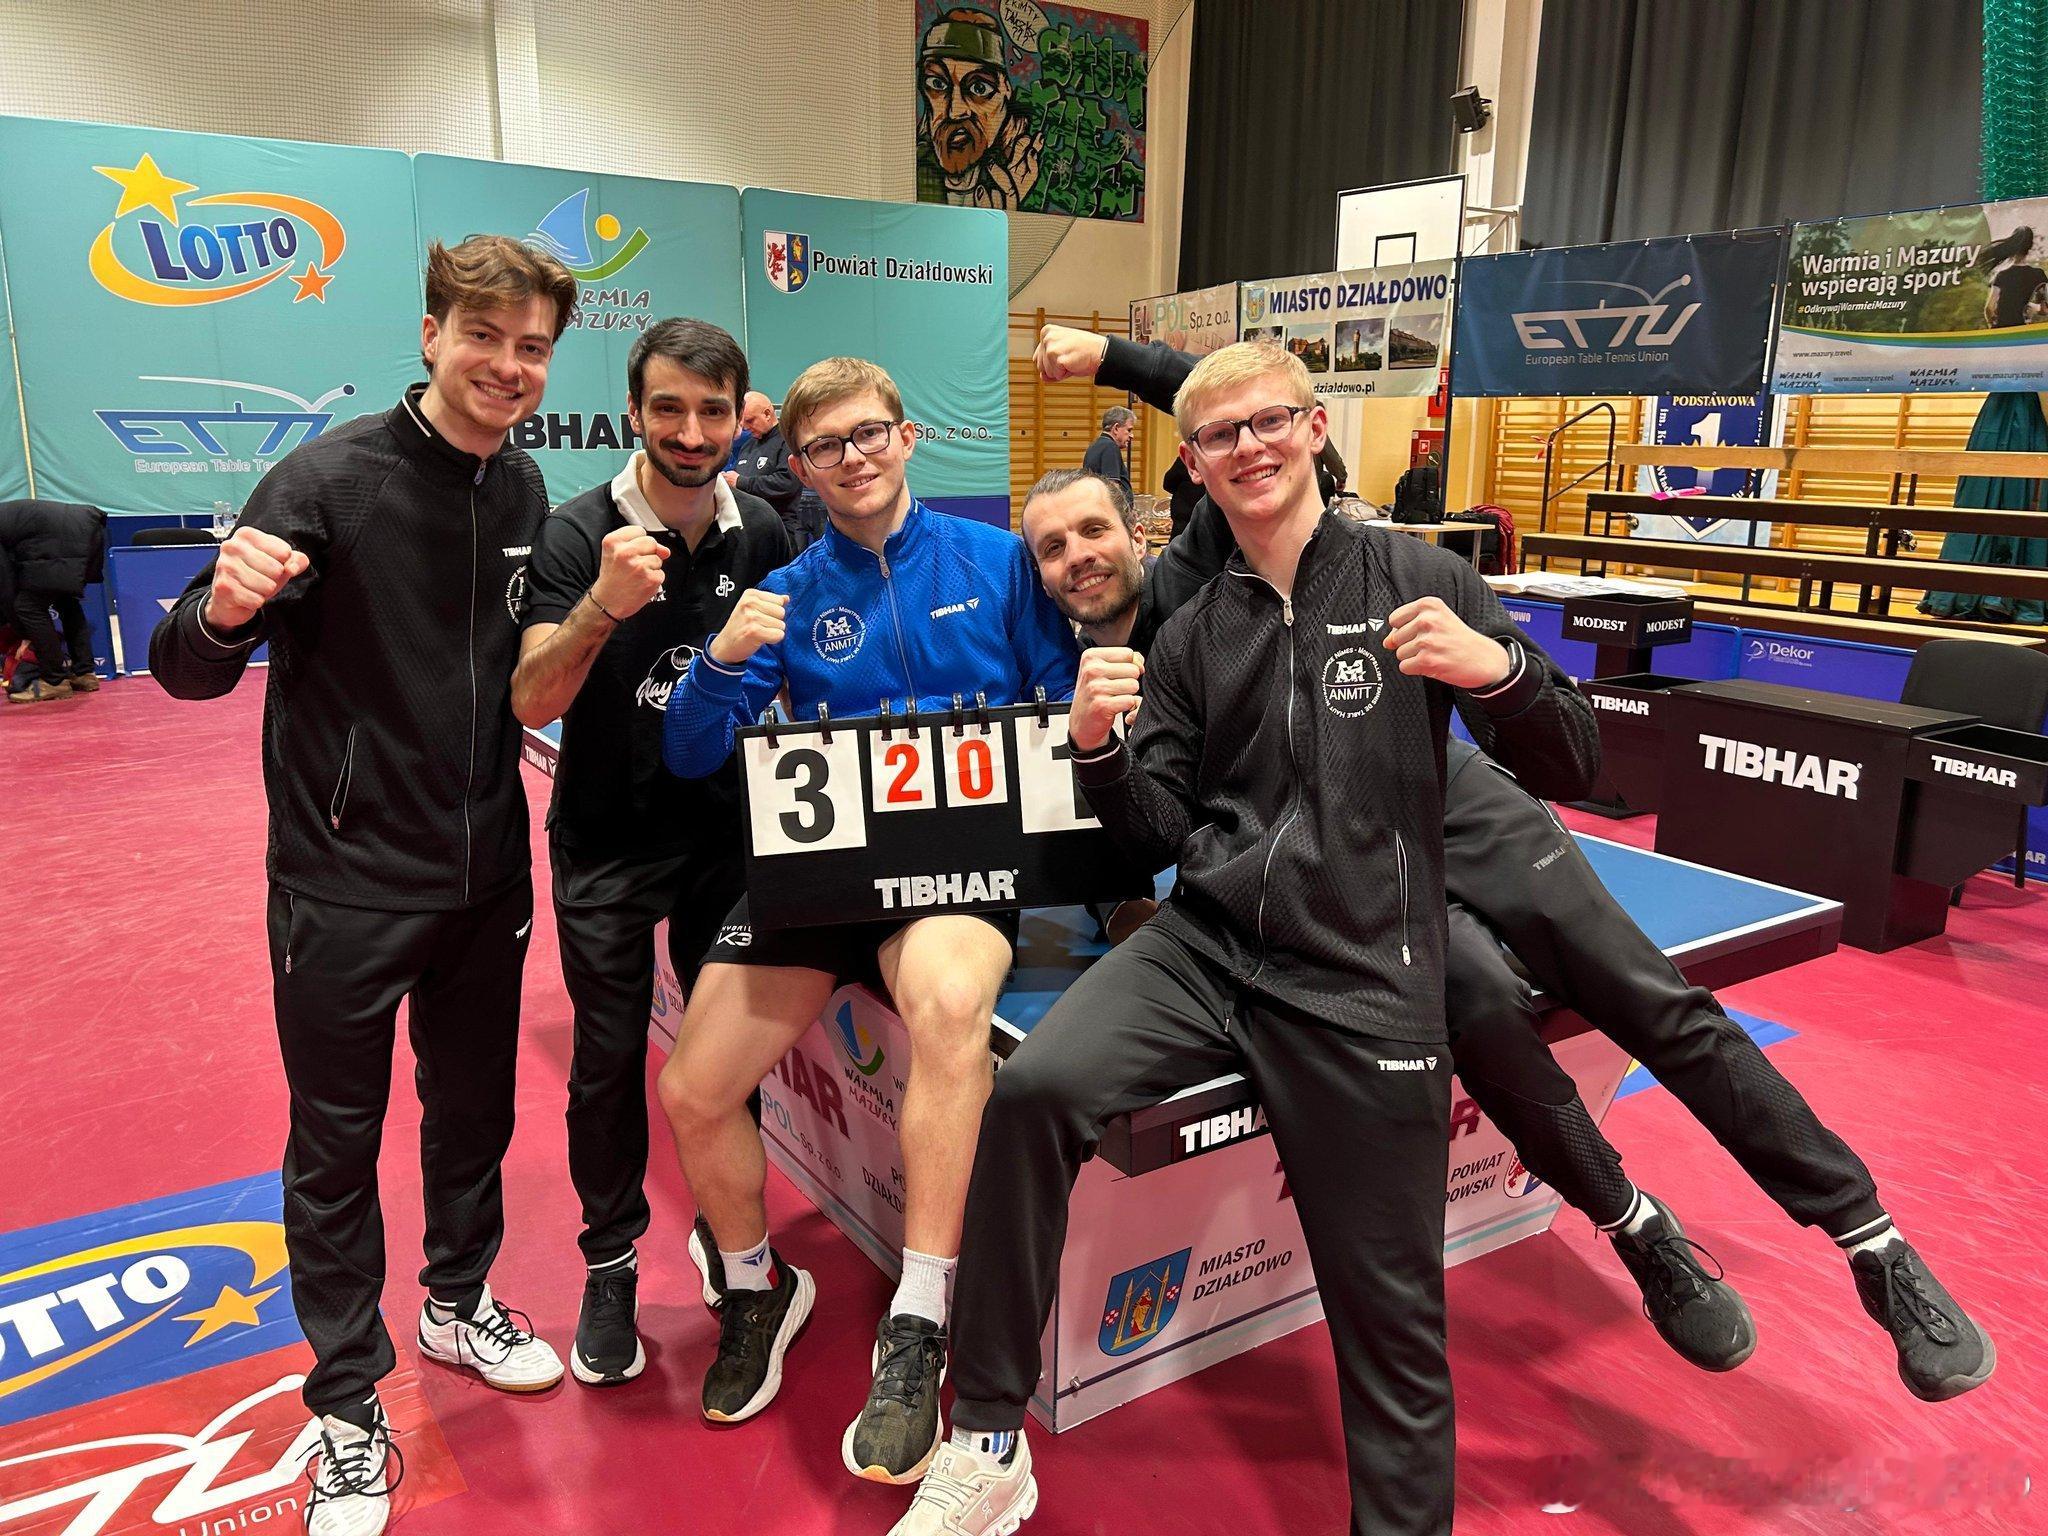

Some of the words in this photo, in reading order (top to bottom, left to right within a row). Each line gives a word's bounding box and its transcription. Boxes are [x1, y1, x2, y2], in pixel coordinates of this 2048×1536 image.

[138, 216, 298, 281] LOTTO
[1802, 249, 1880, 275] Warmia
[1885, 248, 1892, 268] i
[1897, 244, 1982, 268] Mazury
[813, 250, 878, 277] Powiat
[886, 258, 993, 284] Działdowski
[580, 287, 650, 309] RMIA
[1270, 287, 1331, 314] MIASTO
[1337, 274, 1447, 308] DZIAŁDOWO
[1801, 271, 1898, 300] wspierają
[1903, 267, 1961, 294] sport
[566, 310, 653, 332] AZURY
[1511, 300, 1701, 349] ETTU
[1525, 353, 1575, 366] European
[1578, 353, 1602, 365] Table
[1605, 352, 1635, 364] Tennis
[1638, 351, 1669, 362] Union
[1672, 396, 1755, 407] PODSTAWOWA
[510, 412, 641, 451] BHA
[914, 422, 941, 444] Sp.
[946, 427, 957, 440] z
[961, 426, 993, 440] o.o.
[1691, 412, 1721, 447] 1
[134, 459, 208, 474] European
[213, 459, 251, 473] Table
[930, 603, 966, 619] TIBHAR
[1573, 616, 1627, 631] MODEST
[1646, 618, 1686, 633] MODEST
[824, 636, 858, 653] ANMTT
[1325, 623, 1367, 635] TIBHAR
[1769, 642, 1815, 660] Dekor
[1328, 686, 1372, 700] ANMTT
[1591, 694, 1650, 716] TIBHAR
[1699, 734, 1860, 800] TIBHAR
[1931, 755, 2017, 788] TIBHAR
[774, 748, 836, 844] 3
[884, 743, 922, 804] 2
[956, 739, 994, 800] 0
[874, 869, 1017, 909] TIBHAR
[716, 931, 753, 947] K3
[1377, 1059, 1425, 1071] TIBHAR
[845, 1067, 894, 1113] WARMIA
[850, 1085, 897, 1131] MAZURY
[1180, 1103, 1270, 1153] TIBHA
[1450, 1151, 1506, 1183] POWIAT
[1199, 1238, 1266, 1277] MIASTO
[1192, 1250, 1292, 1301] DZIAŁDOWO
